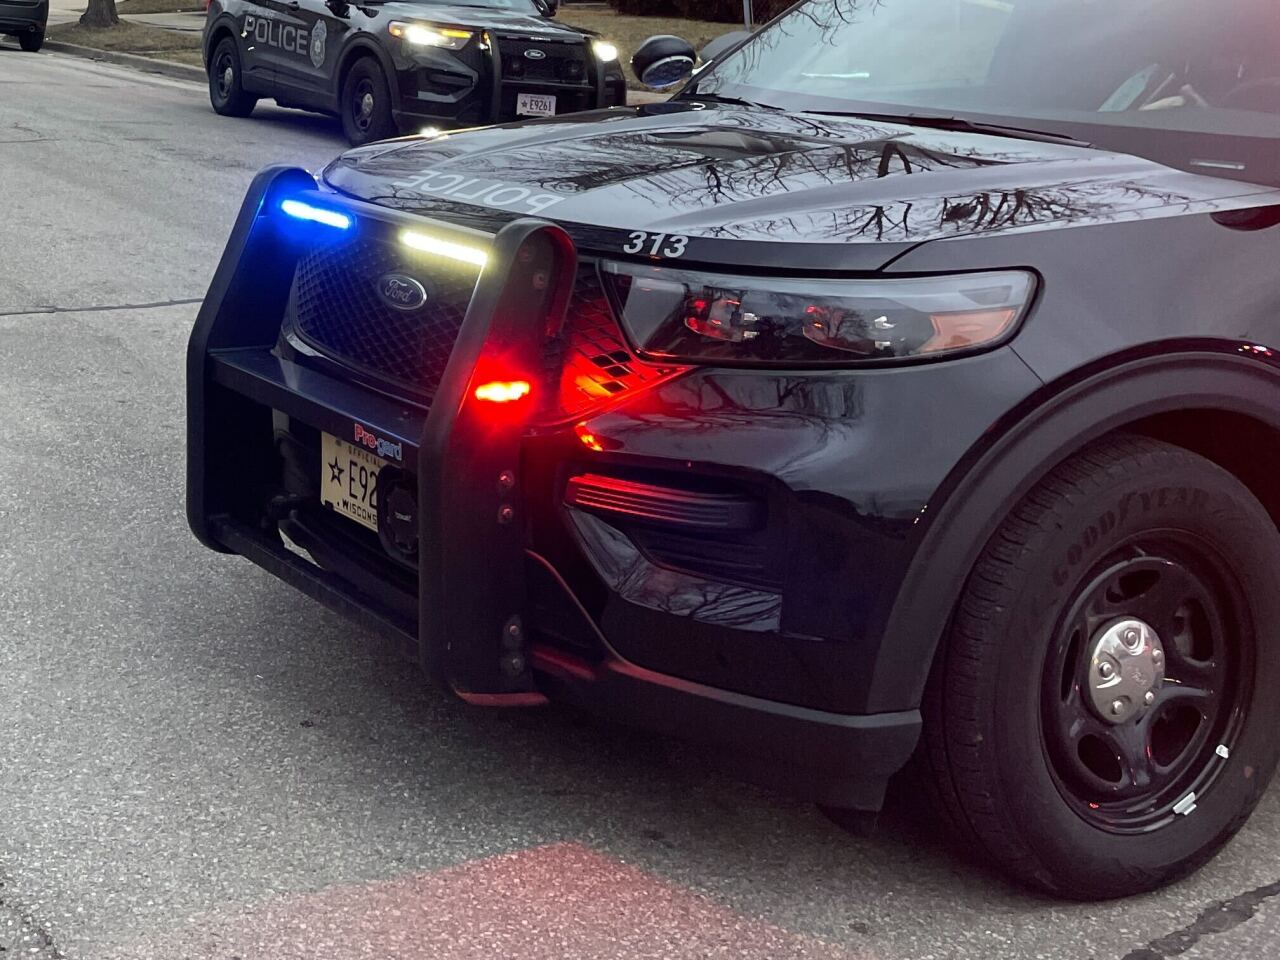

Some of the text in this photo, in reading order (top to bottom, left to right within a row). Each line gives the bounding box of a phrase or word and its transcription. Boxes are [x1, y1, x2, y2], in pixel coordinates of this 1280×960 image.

[242, 15, 308, 56] POLICE
[529, 99, 552, 112] E9261
[623, 231, 689, 258] 313
[384, 279, 414, 302] Ford
[349, 459, 378, 511] E92
[342, 498, 378, 525] WISCONS
